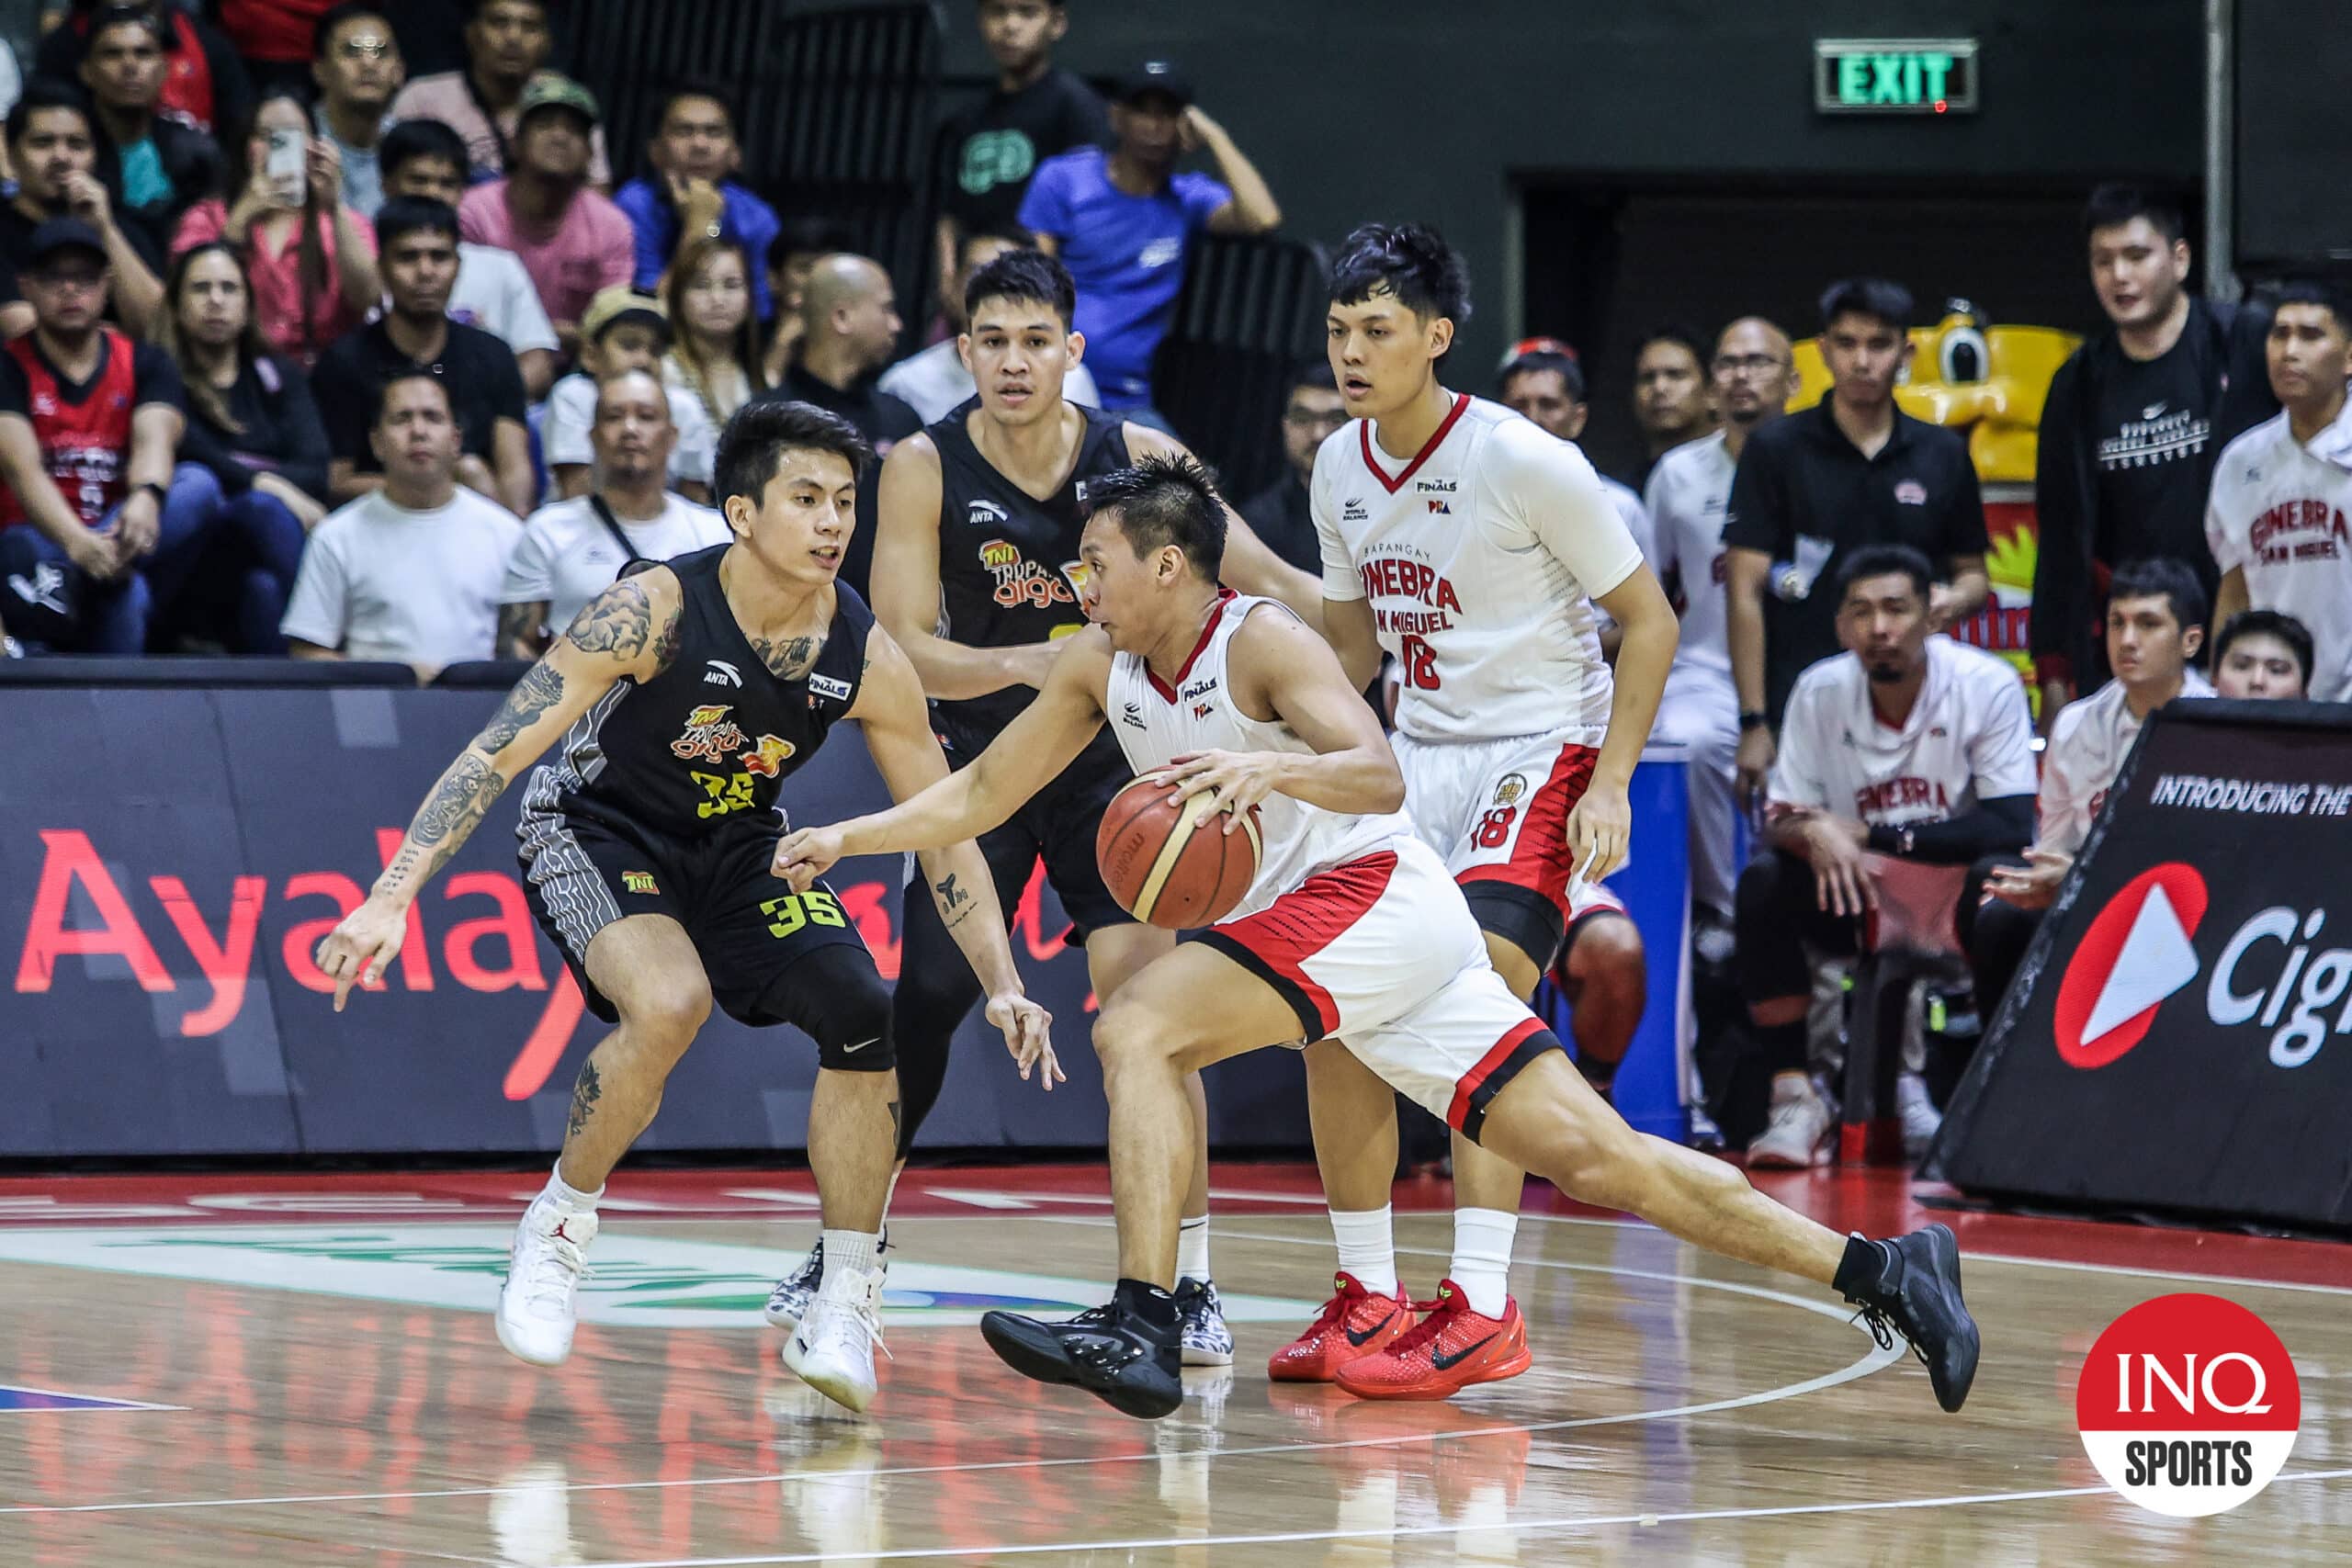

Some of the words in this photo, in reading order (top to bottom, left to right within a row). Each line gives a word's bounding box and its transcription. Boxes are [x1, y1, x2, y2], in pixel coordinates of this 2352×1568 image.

[1838, 52, 1953, 104] EXIT
[1417, 481, 1457, 493] FINALS
[970, 512, 993, 524] ANTA
[2250, 499, 2348, 553] GINEBRA
[1363, 543, 1431, 561] BARANGAY
[1359, 559, 1464, 616] INEBRA
[1390, 610, 1454, 636] MIGUEL
[704, 671, 729, 687] ANTA
[1402, 634, 1441, 691] 18
[810, 679, 847, 696] FINALS
[1184, 677, 1217, 702] FINALS
[691, 771, 755, 818] 35
[2151, 773, 2310, 816] INTRODUCING
[2309, 784, 2352, 816] THE
[1471, 806, 1517, 852] 18
[626, 874, 655, 892] TNT
[759, 890, 846, 939] 35
